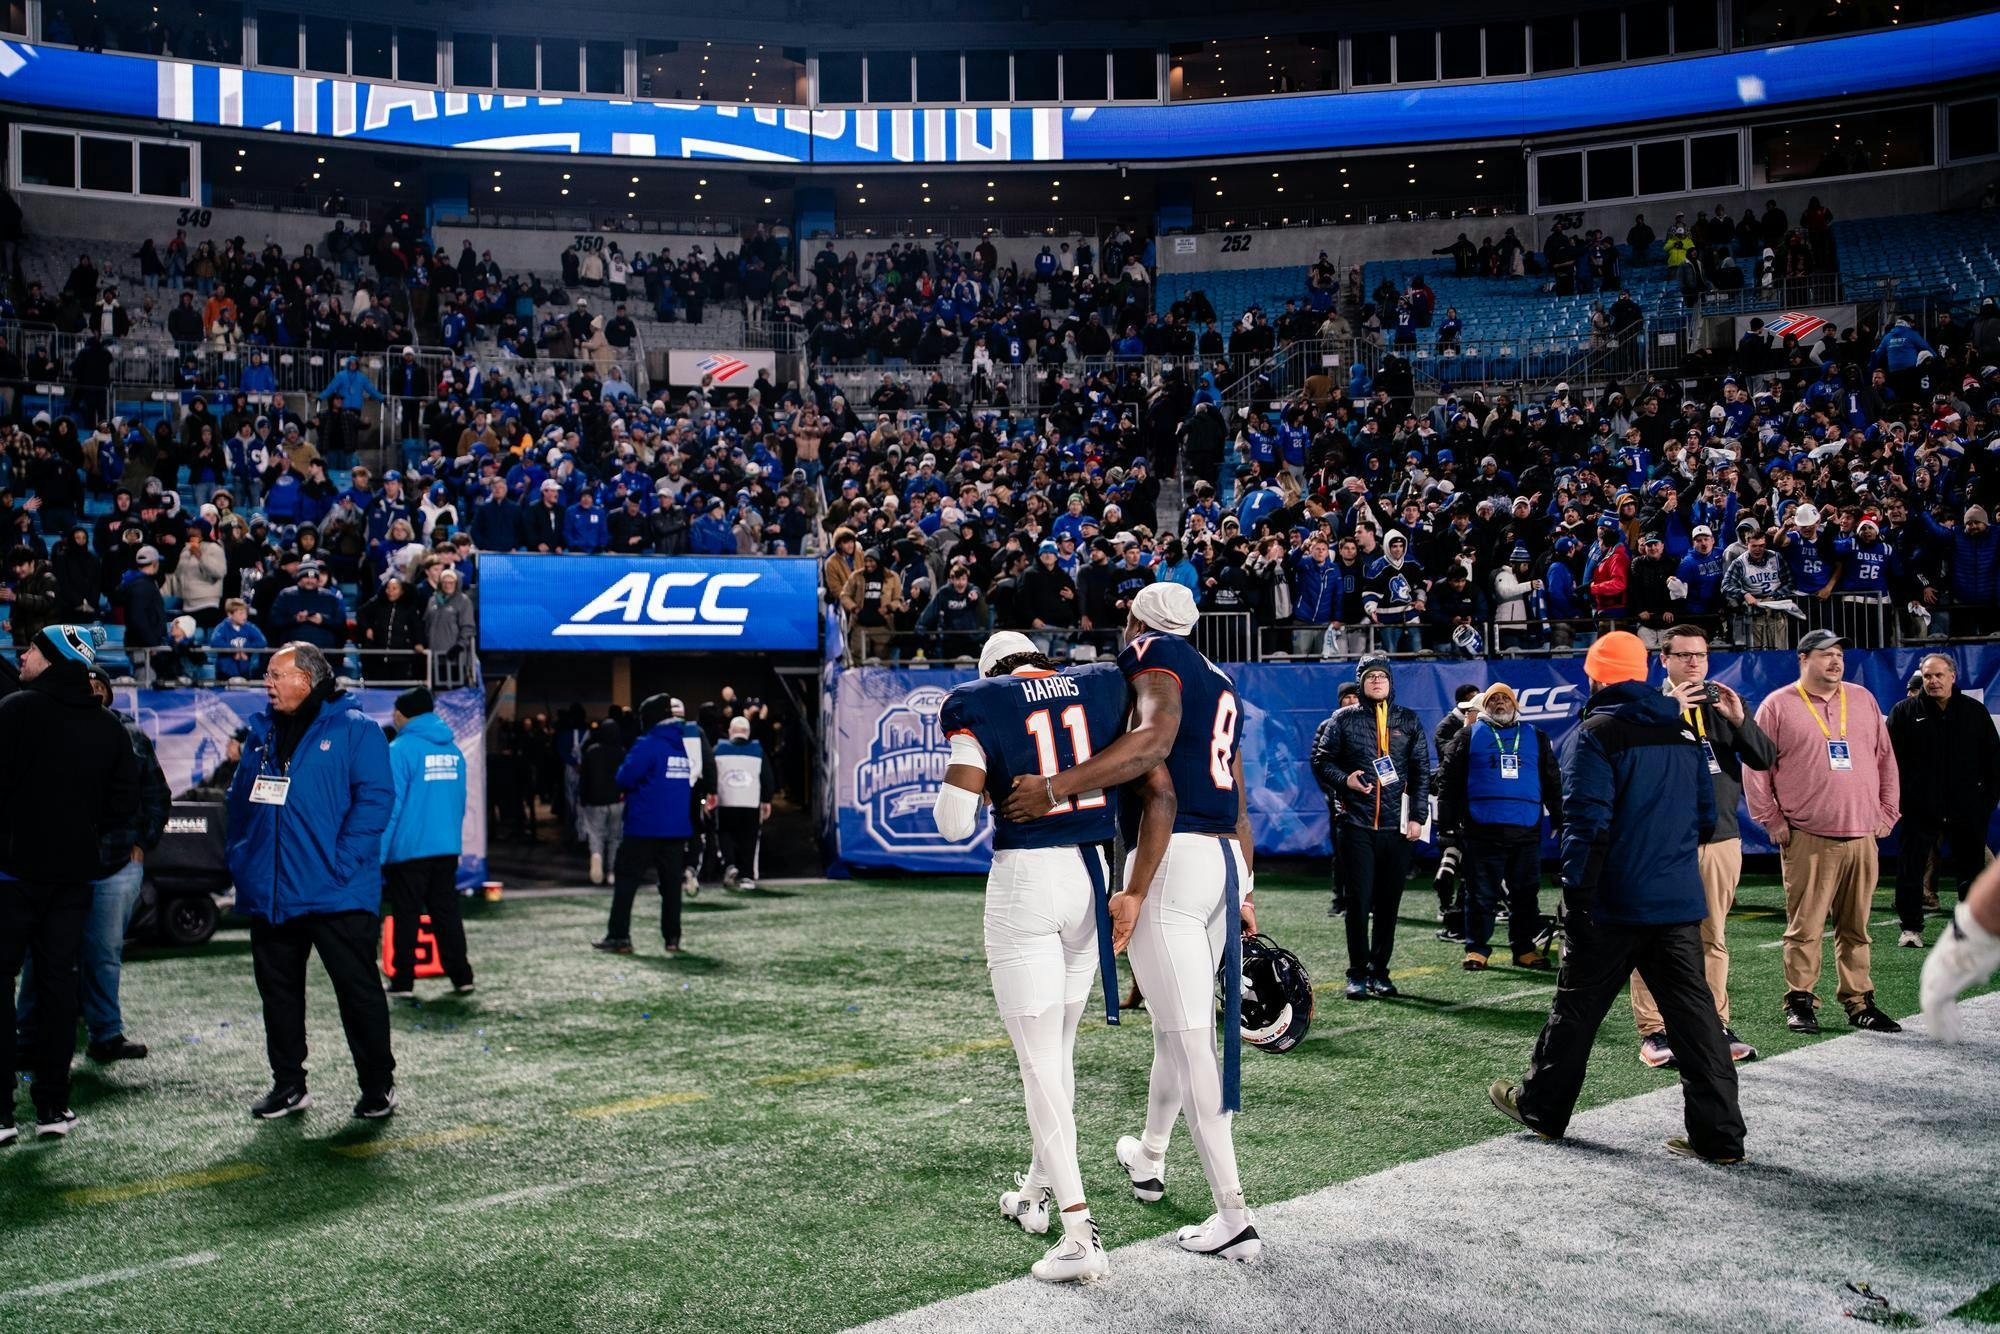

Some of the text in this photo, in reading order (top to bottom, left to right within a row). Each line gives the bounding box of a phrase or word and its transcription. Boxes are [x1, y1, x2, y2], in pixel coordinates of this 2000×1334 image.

[176, 207, 212, 228] 349
[574, 234, 605, 252] 350
[1220, 234, 1252, 252] 252
[1010, 342, 1020, 357] 6
[1849, 394, 1858, 413] 1
[1632, 454, 1642, 472] 1
[1251, 492, 1264, 509] 1
[1749, 571, 1778, 584] DUKE
[1858, 564, 1881, 579] 26
[570, 572, 761, 622] ACC
[1760, 582, 1772, 594] 2
[1021, 676, 1080, 703] HARRIS
[1515, 684, 1579, 713] CC
[1210, 690, 1238, 791] 8
[1025, 704, 1107, 817] 11
[860, 751, 952, 802] CHAMPIO
